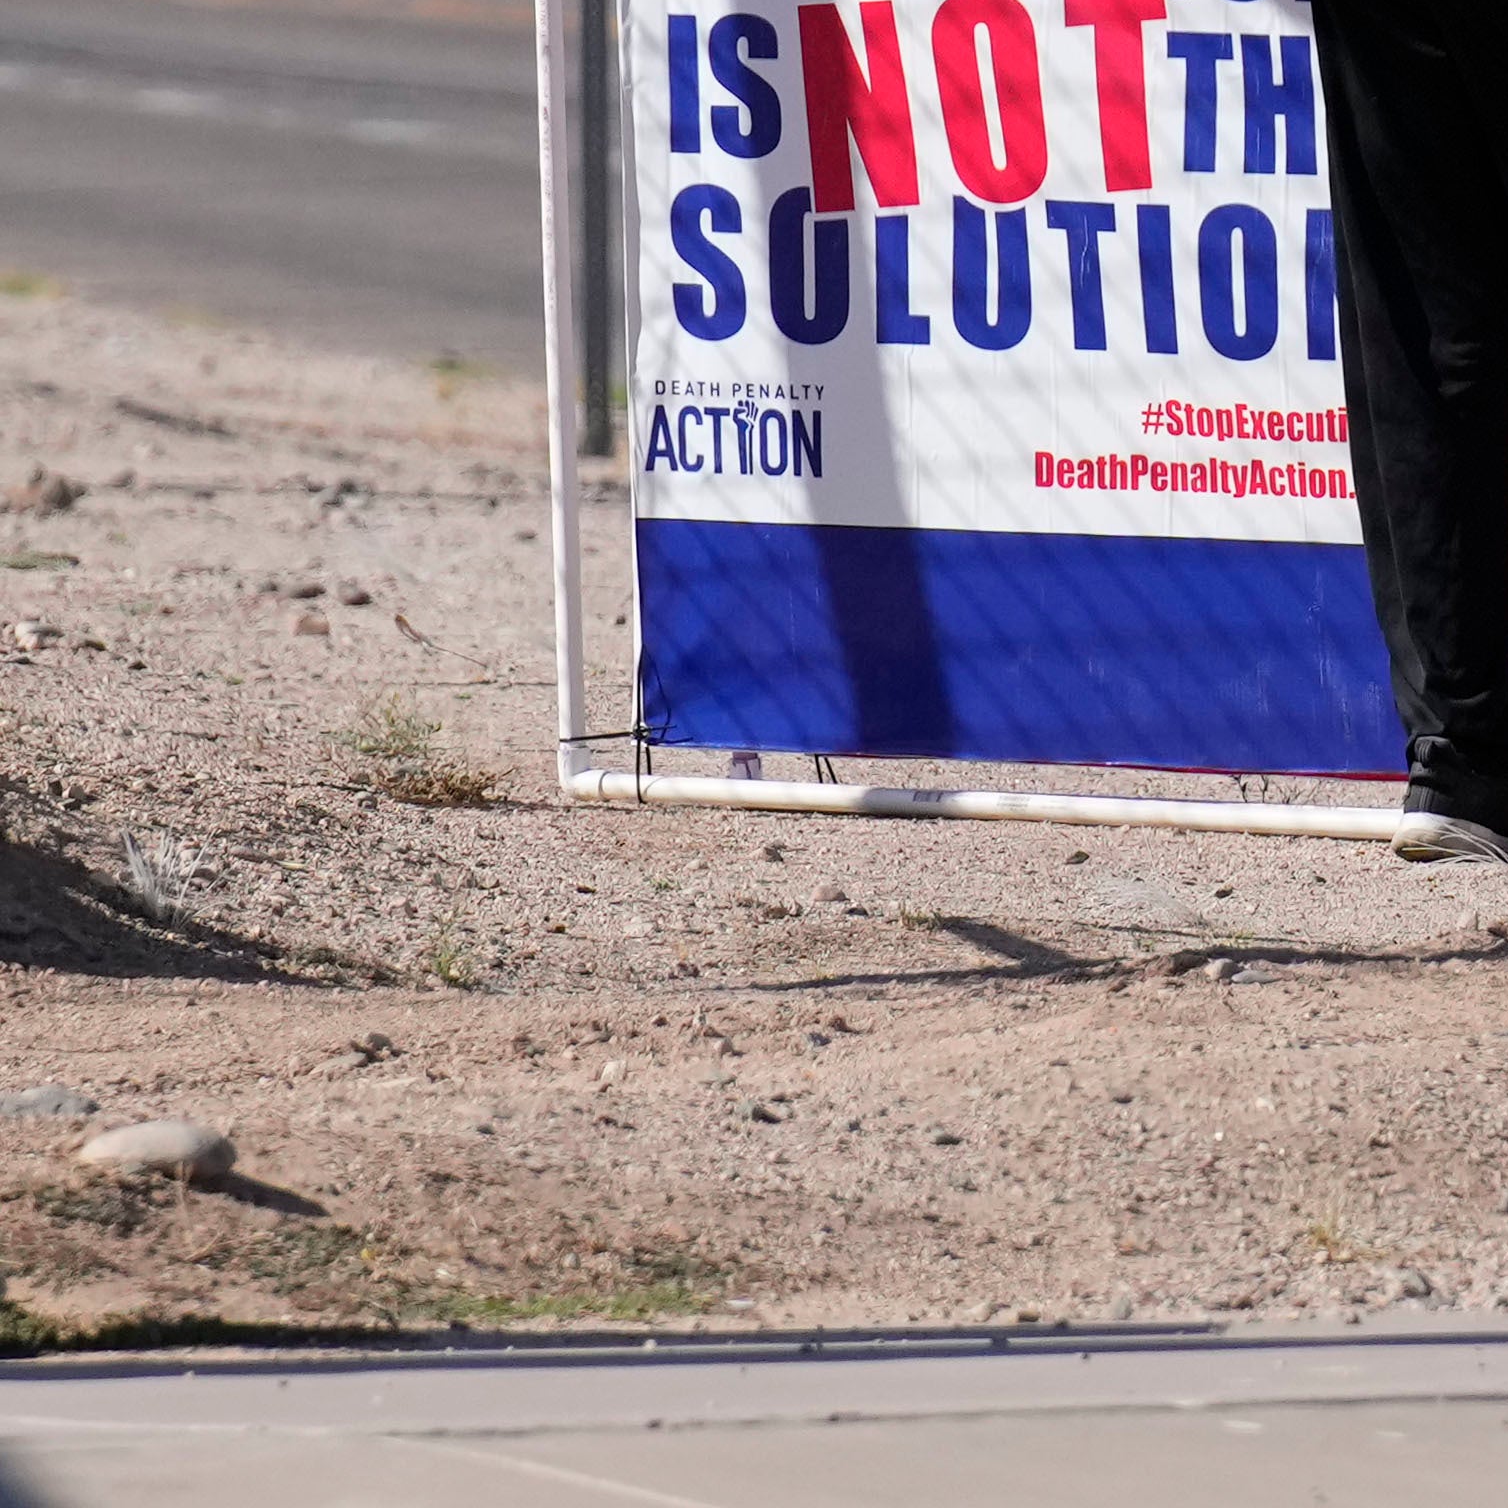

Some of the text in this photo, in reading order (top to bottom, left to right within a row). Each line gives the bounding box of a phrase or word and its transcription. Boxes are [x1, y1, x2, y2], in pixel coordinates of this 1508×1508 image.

[668, 13, 783, 159] IS
[1167, 32, 1318, 176] TH
[655, 380, 825, 400] DEATH PENALTY
[1142, 400, 1349, 443] #StopExecuti
[1035, 452, 1357, 500] DeathPenaltyAction.
